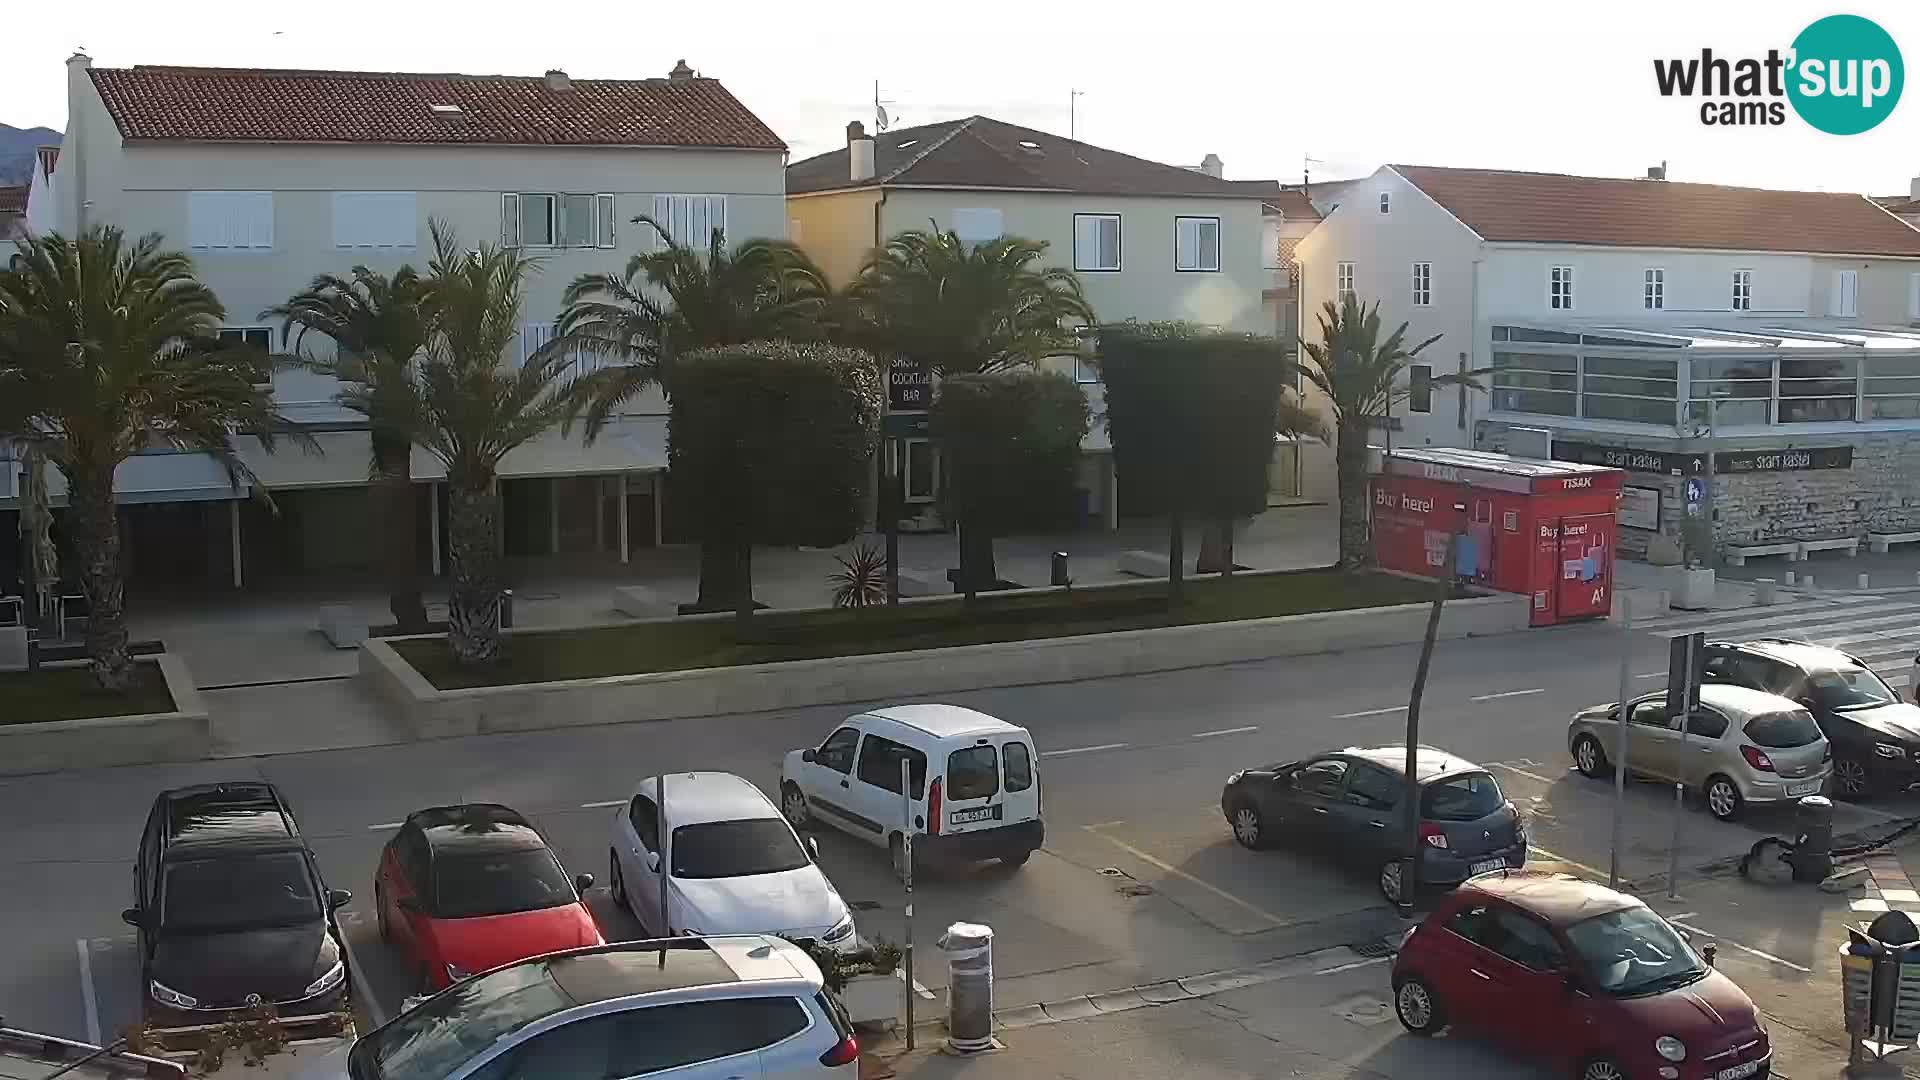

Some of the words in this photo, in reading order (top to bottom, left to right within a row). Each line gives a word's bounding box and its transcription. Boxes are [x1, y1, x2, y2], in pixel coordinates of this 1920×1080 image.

[903, 389, 920, 401] BAR
[1562, 476, 1592, 489] TISAK
[1376, 487, 1398, 509] Buy
[1402, 492, 1434, 513] here!
[1540, 525, 1559, 539] Buy
[1563, 522, 1588, 536] here!
